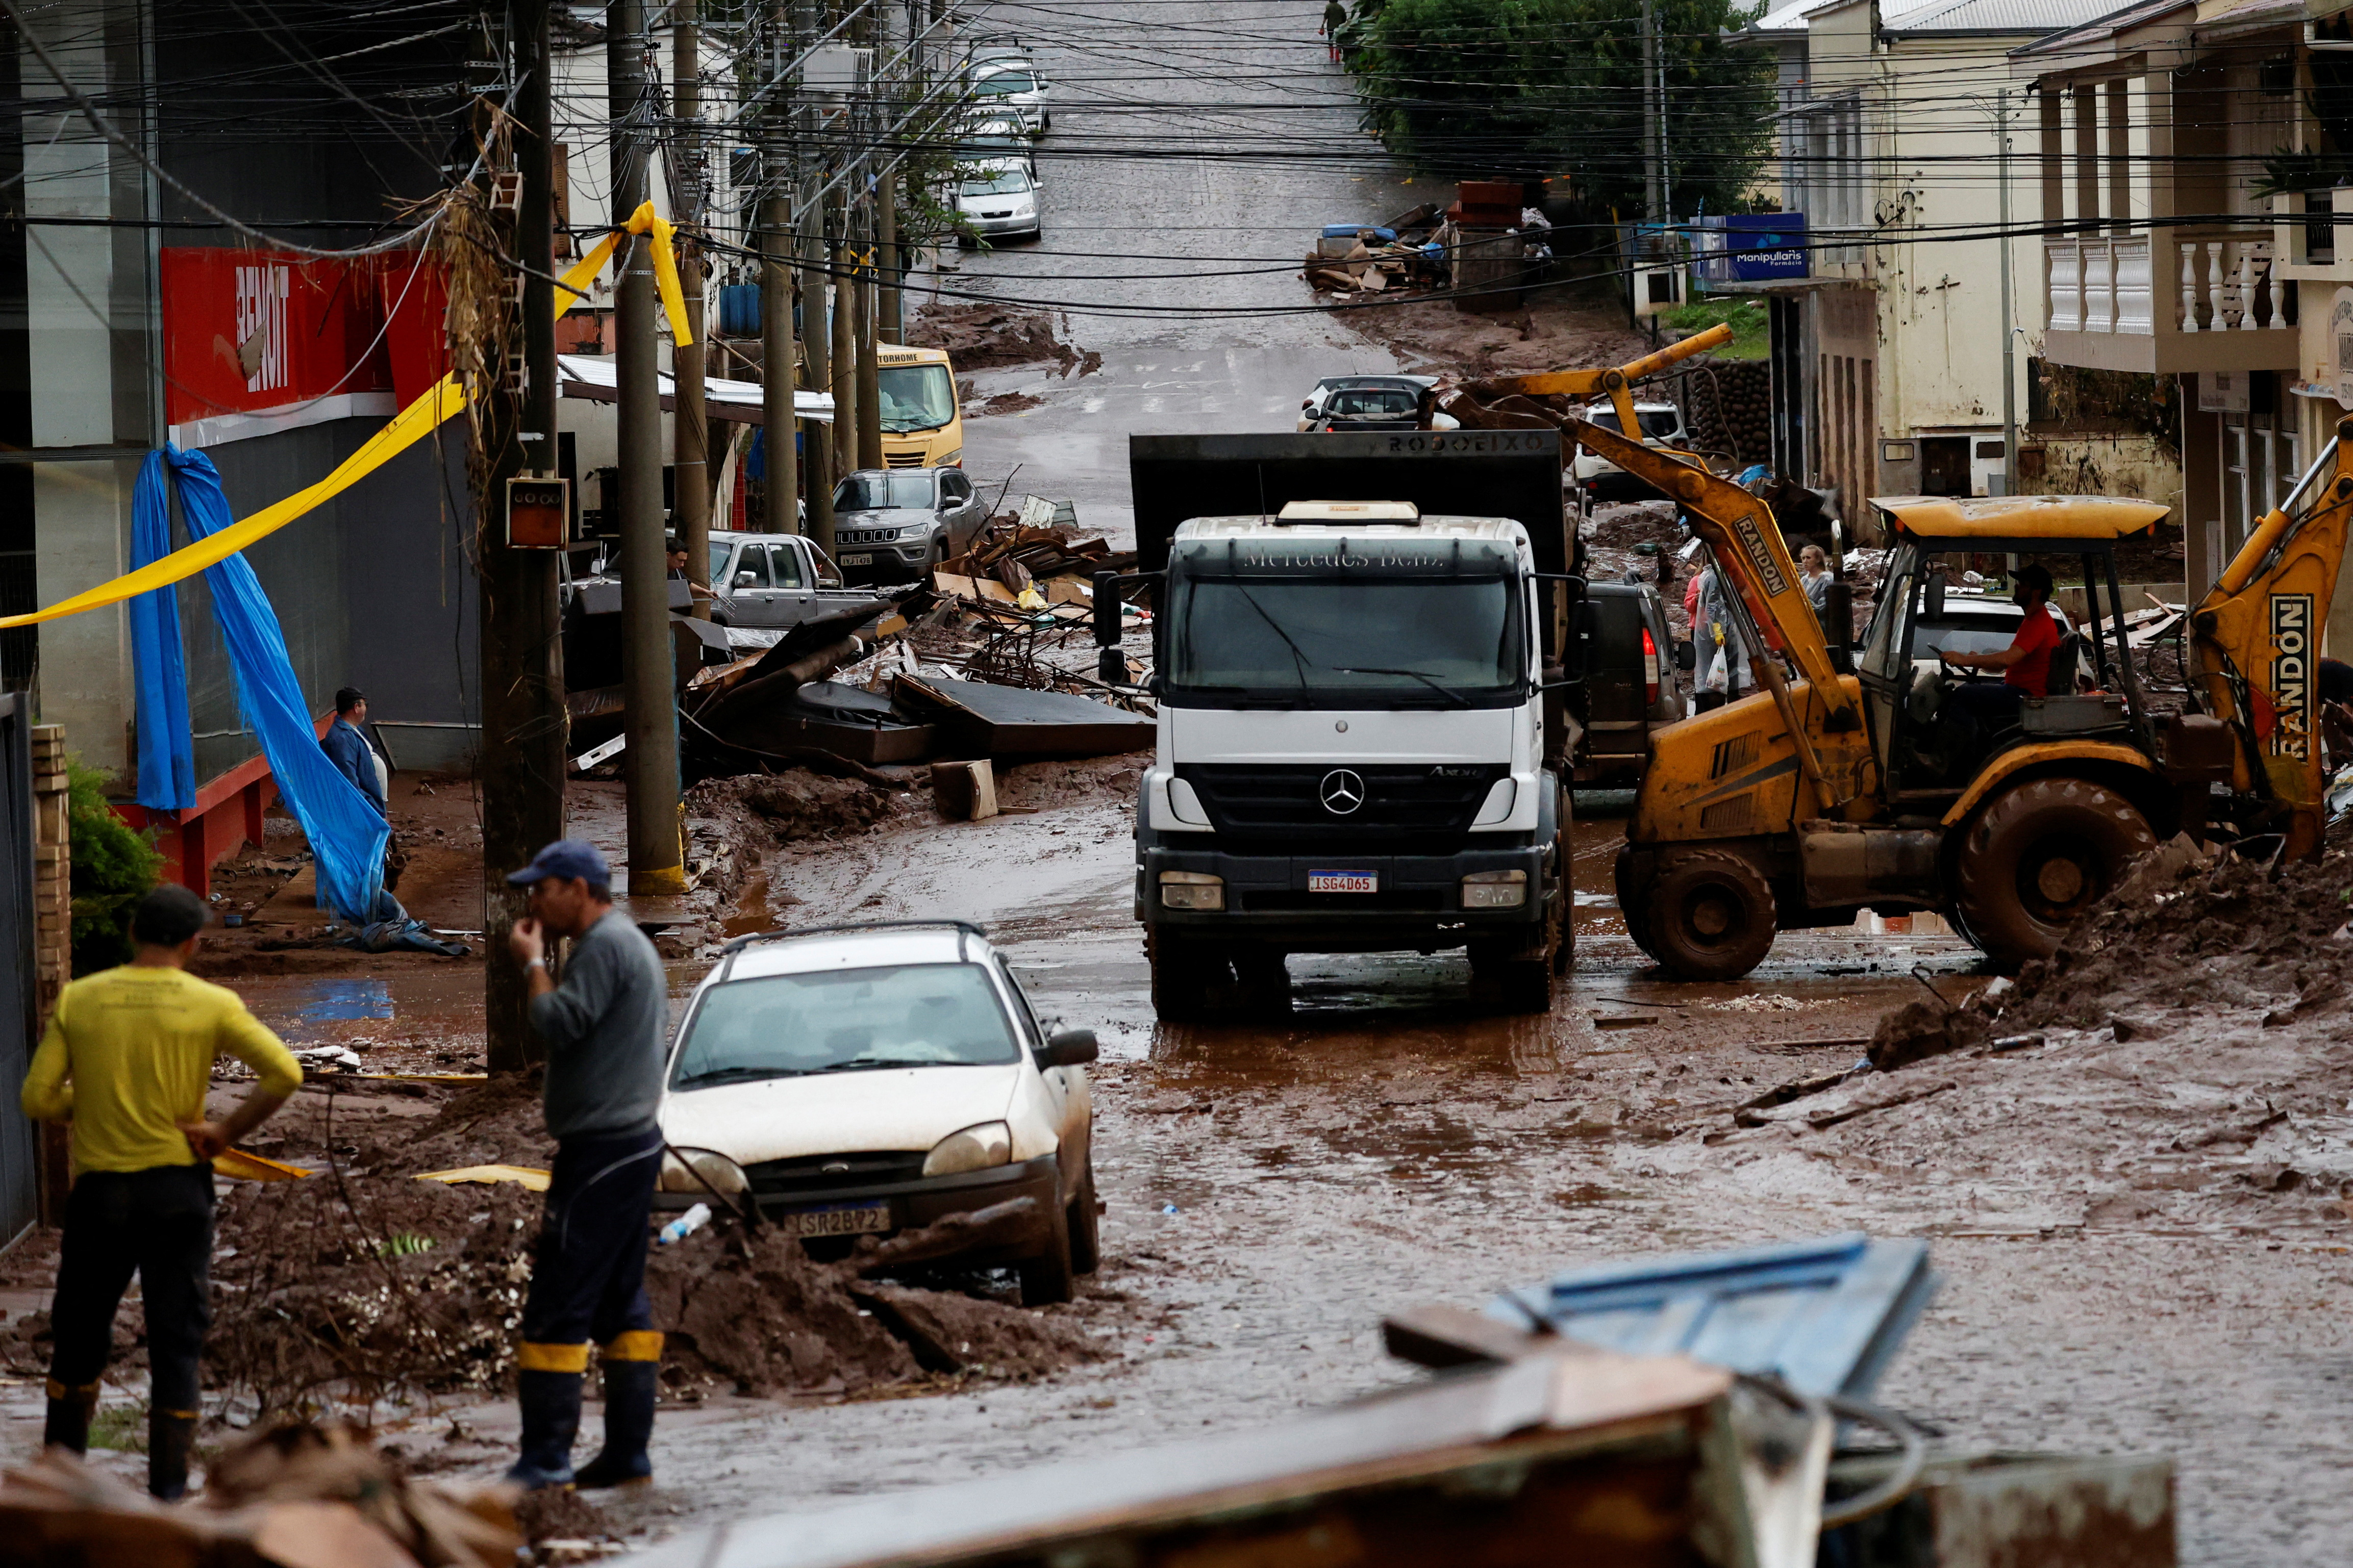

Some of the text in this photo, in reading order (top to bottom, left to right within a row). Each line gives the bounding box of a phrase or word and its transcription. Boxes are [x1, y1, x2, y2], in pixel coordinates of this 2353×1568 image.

[1737, 251, 1801, 263] Manipullaris
[236, 262, 289, 392] BENOIT
[878, 353, 918, 363] TORHOME
[1389, 435, 1543, 451] RODOEIXO
[1739, 519, 1784, 591] RANDON
[2280, 603, 2304, 758] RANDON
[1315, 877, 1370, 890] ISG4D65
